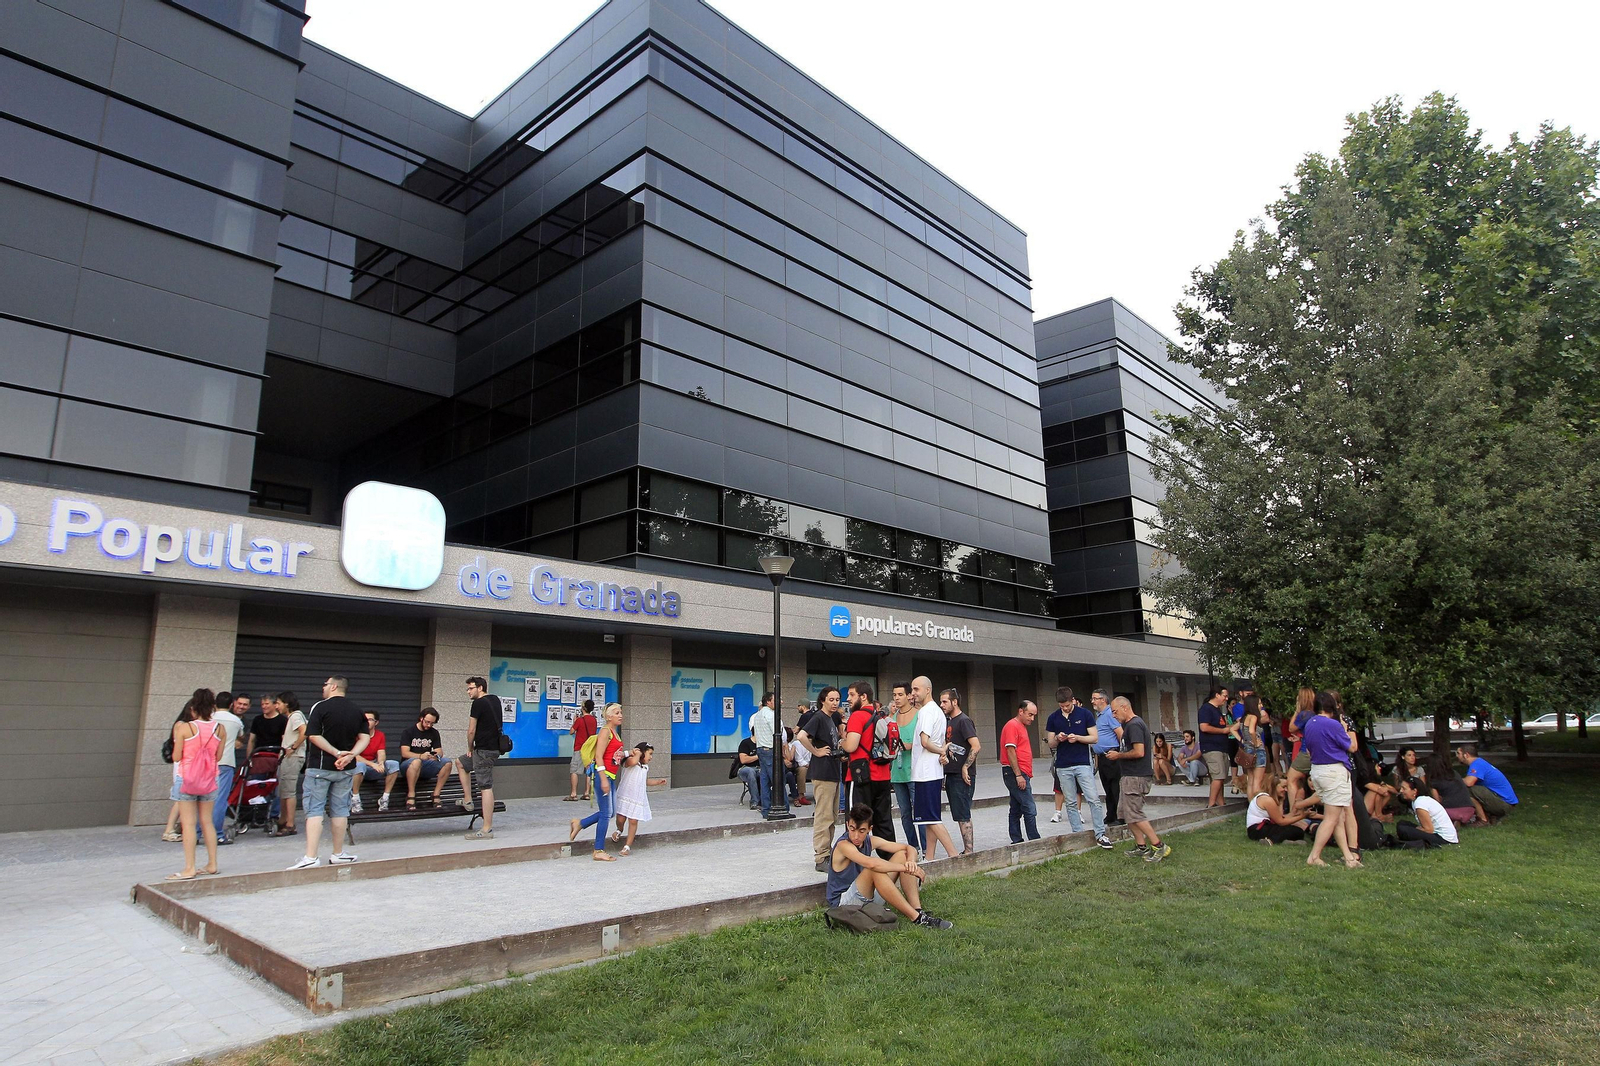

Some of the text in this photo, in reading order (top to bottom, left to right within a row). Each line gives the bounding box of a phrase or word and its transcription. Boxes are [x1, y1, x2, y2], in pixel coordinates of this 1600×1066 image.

[48, 497, 315, 577] Popular
[458, 556, 682, 618] de Granada
[831, 618, 849, 627] PP
[856, 614, 975, 643] populares Granada
